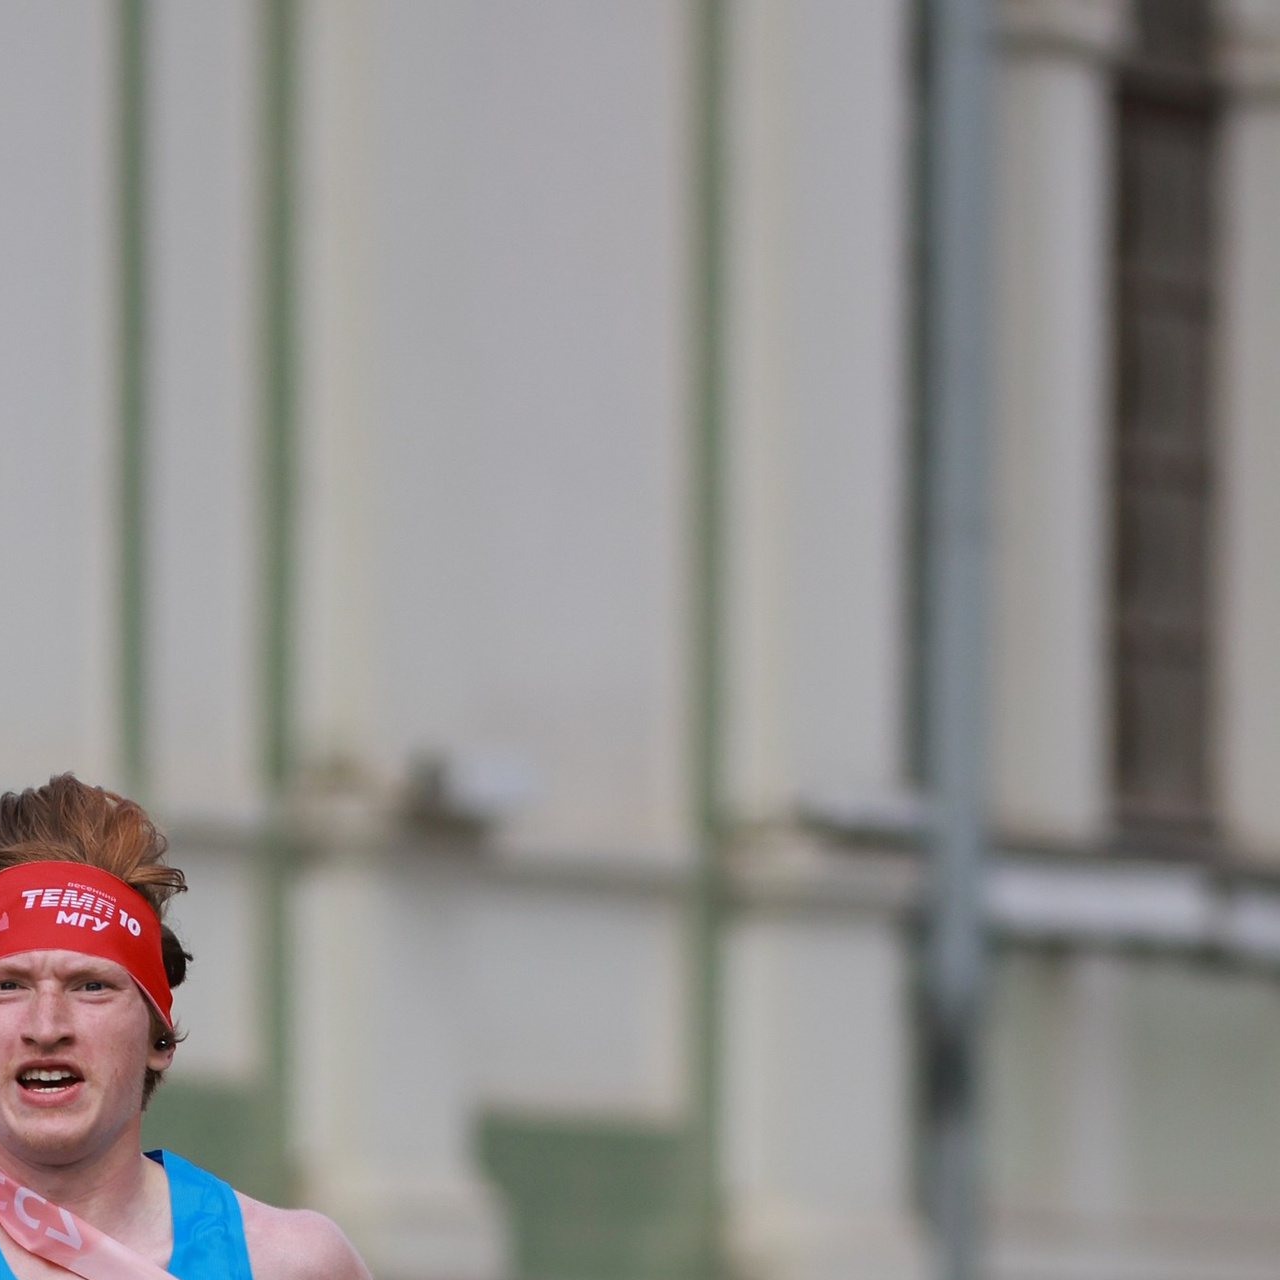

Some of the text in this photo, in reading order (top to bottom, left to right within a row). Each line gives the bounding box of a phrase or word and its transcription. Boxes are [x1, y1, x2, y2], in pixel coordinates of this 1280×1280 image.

[22, 888, 116, 919] ТЕМП
[67, 882, 117, 903] весенний
[56, 911, 110, 932] МГУ
[119, 909, 141, 936] 10
